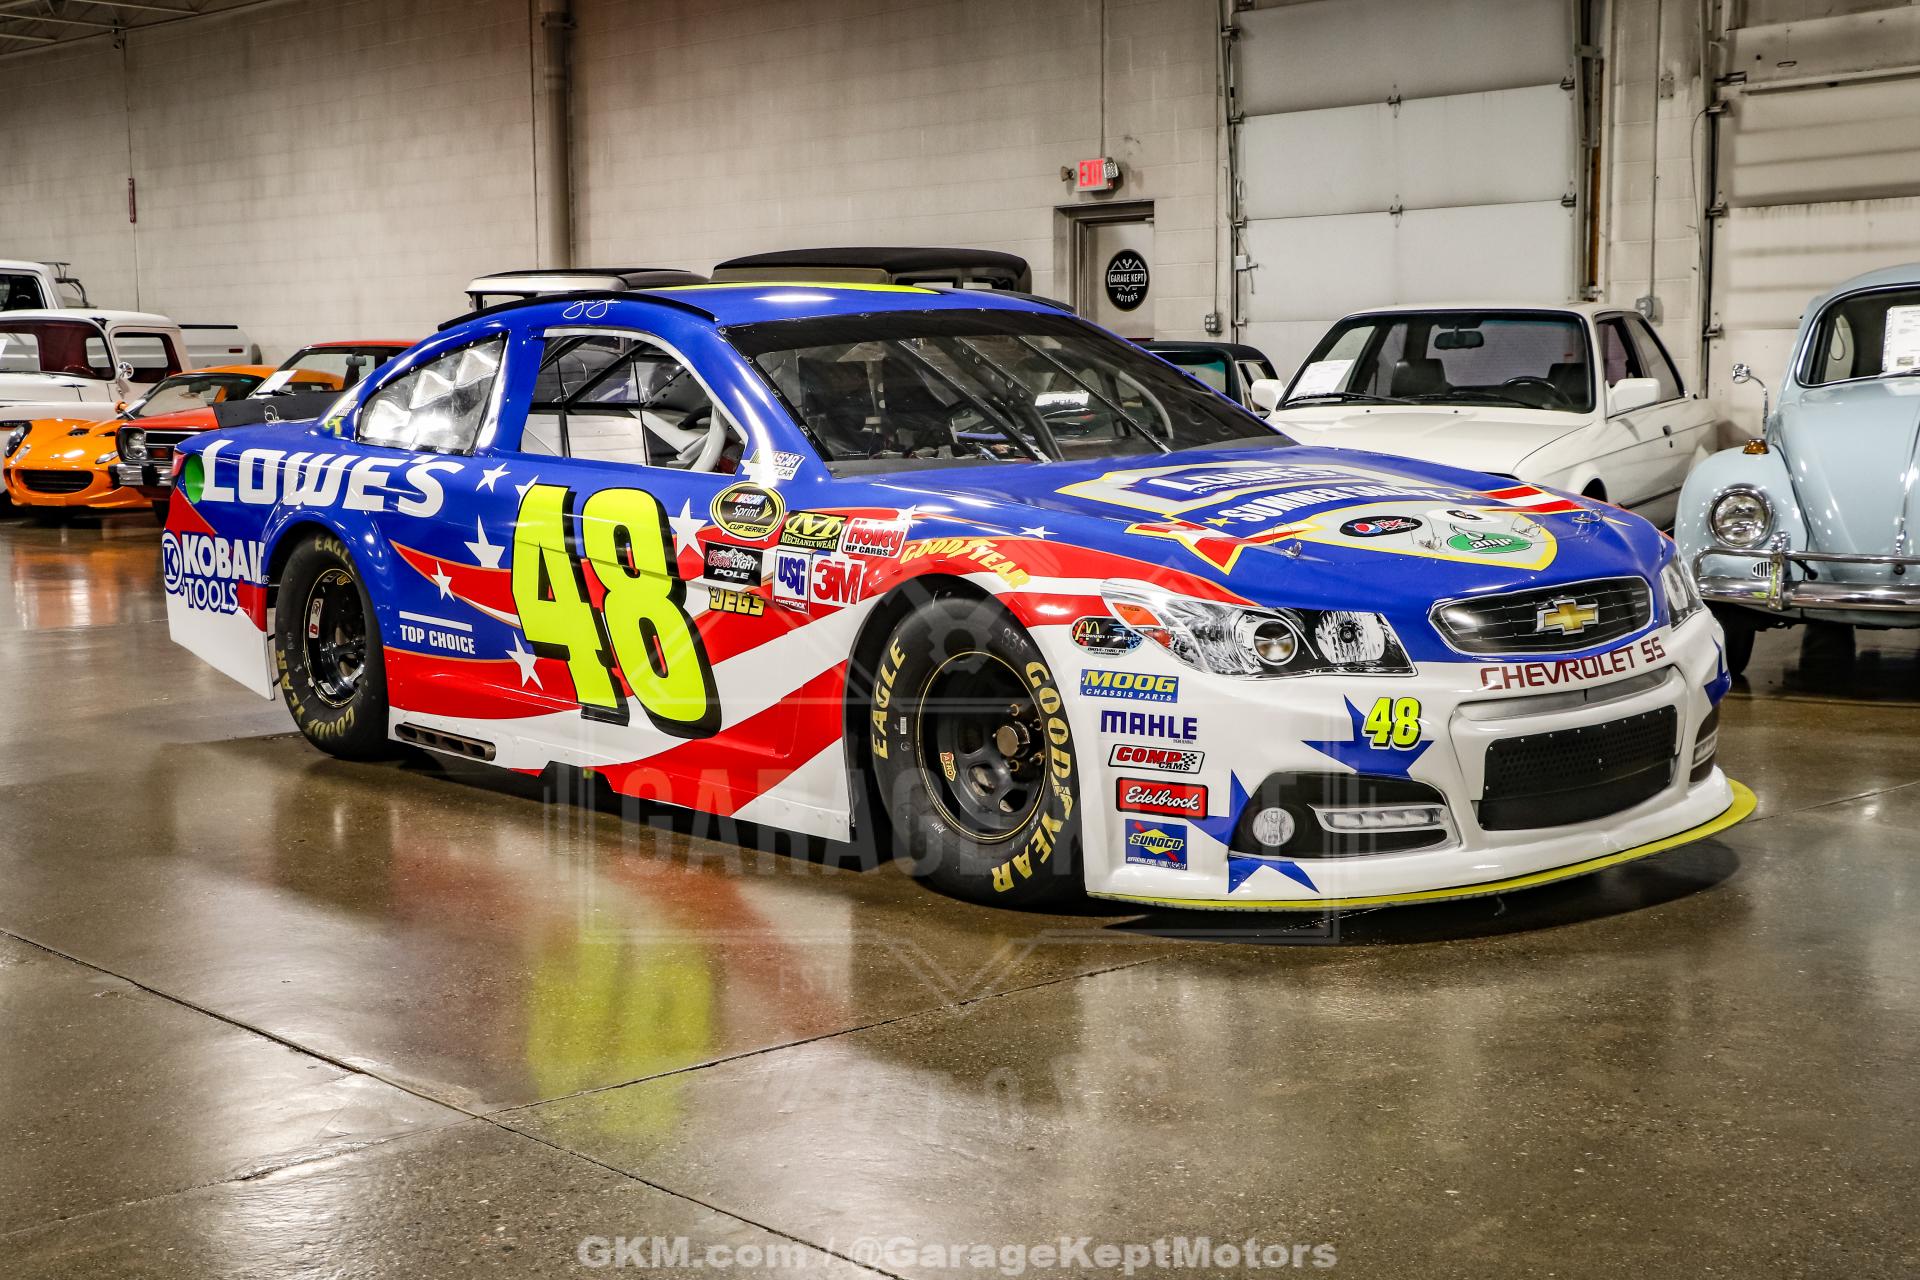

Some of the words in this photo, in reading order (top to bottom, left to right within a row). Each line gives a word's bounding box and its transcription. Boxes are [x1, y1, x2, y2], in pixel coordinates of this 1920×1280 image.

[1080, 161, 1103, 186] EXIT
[1111, 274, 1130, 283] GARAGE
[1131, 273, 1144, 282] KEPT
[1117, 292, 1138, 303] MOTORS
[201, 440, 464, 518] LOWE'S
[733, 505, 760, 519] Sprint
[1218, 487, 1358, 522] SUMMER
[729, 523, 743, 531] CUP
[744, 525, 768, 534] SERIES
[780, 533, 815, 548] MECHANIX
[816, 537, 837, 550] WEAR
[845, 544, 857, 553] HP
[859, 546, 888, 557] CARBS
[708, 549, 732, 569] Coors
[731, 555, 759, 571] LIGHT
[900, 539, 1031, 590] GOODYEAR
[714, 568, 749, 580] POLE
[778, 556, 806, 596] USG
[813, 559, 861, 605] 3M
[185, 577, 239, 612] TOOLS
[512, 483, 718, 734] 48
[400, 624, 425, 644] TOP
[429, 631, 476, 655] CHOICE
[1481, 646, 1634, 691] CHEVROLET
[1640, 636, 1667, 663] SS
[1083, 671, 1177, 693] MOOG
[1086, 688, 1133, 698] CHASSIS
[1138, 691, 1172, 701] PARTS
[871, 637, 906, 760] EAGLE
[1101, 710, 1197, 740] MAHLE
[1364, 697, 1421, 748] 48
[1116, 746, 1182, 765] COMP
[1158, 761, 1191, 771] CAMS
[1125, 786, 1200, 811] Edelbrock
[1131, 834, 1182, 850] SUNOCO
